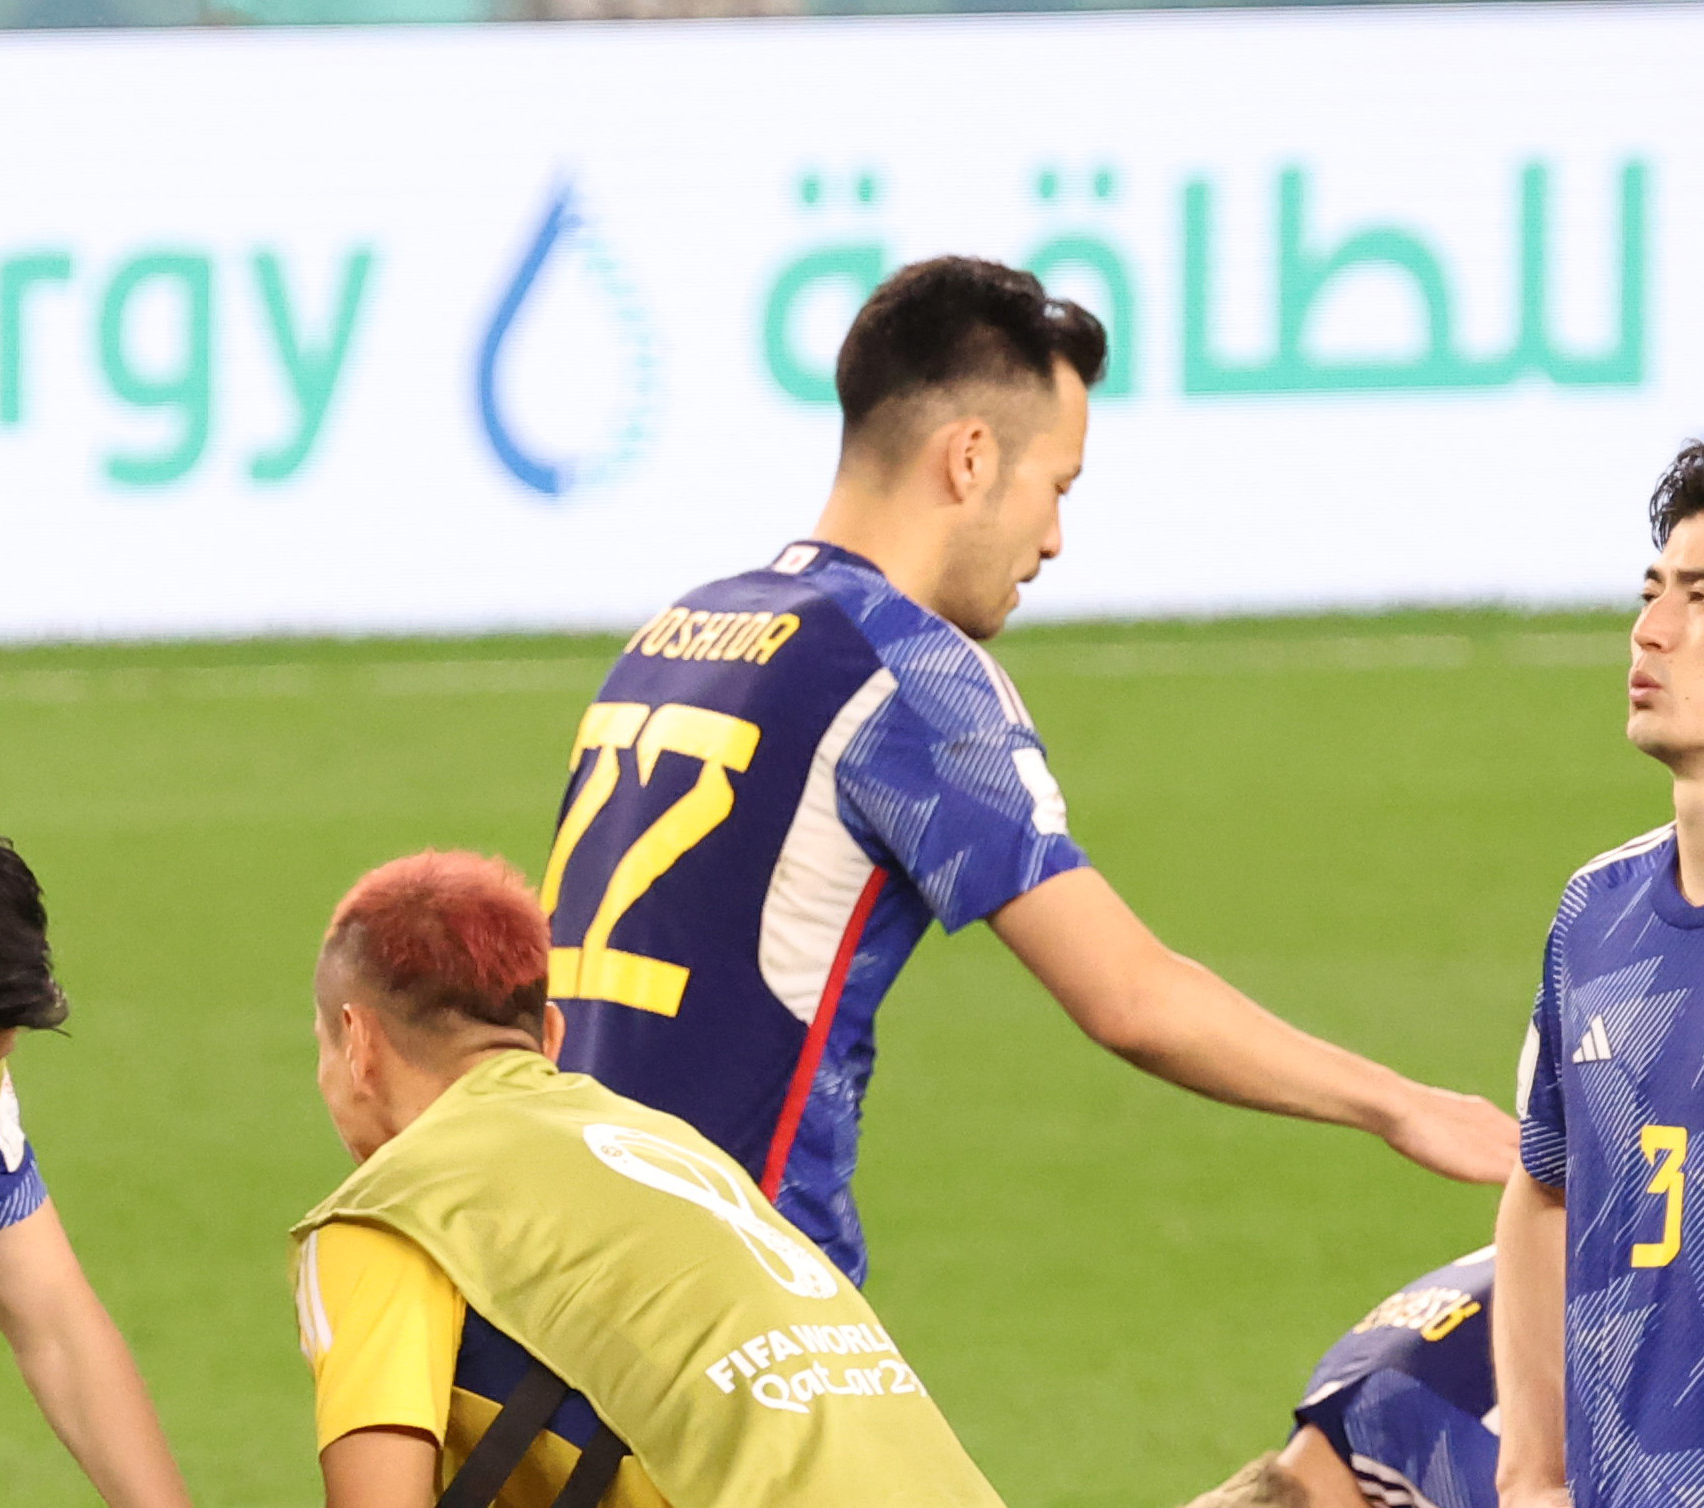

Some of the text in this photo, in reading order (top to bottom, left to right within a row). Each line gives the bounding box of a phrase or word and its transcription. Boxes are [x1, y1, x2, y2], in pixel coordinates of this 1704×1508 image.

[540, 702, 761, 1018] 22
[1631, 1125, 1686, 1268] 3
[705, 1323, 900, 1394] FIFA WORL
